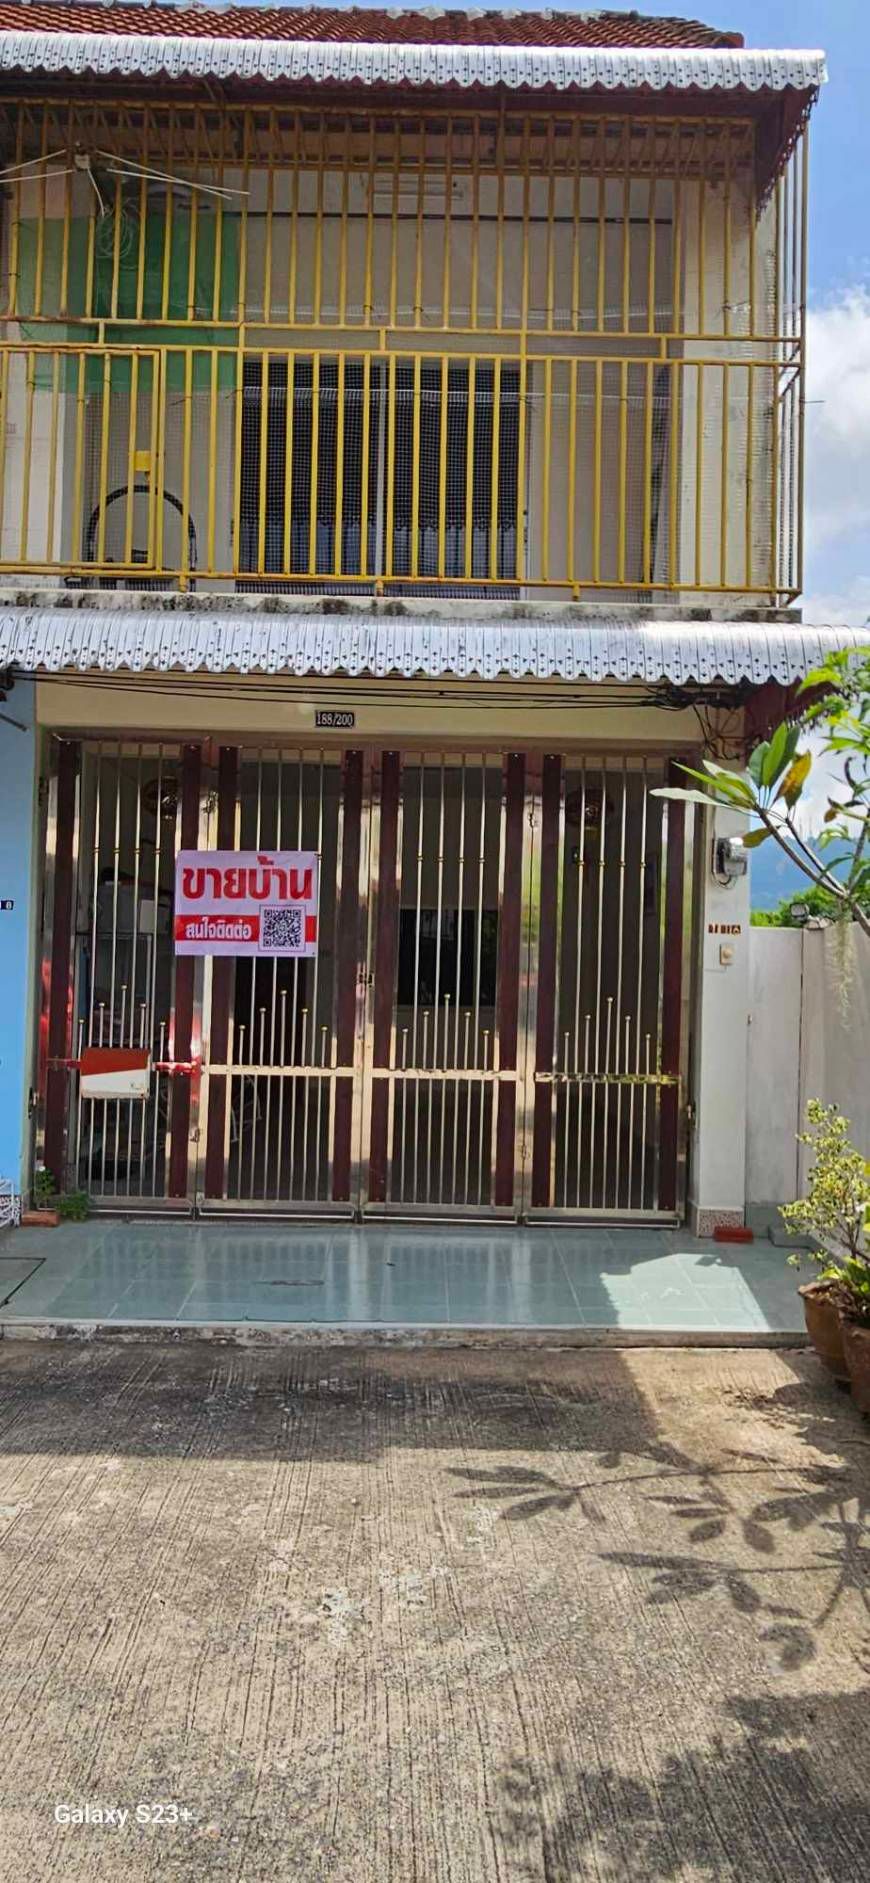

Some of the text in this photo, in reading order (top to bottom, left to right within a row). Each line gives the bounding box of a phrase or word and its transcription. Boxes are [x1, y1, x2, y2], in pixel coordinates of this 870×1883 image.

[317, 712, 353, 726] 188/200
[182, 855, 313, 900] ขายบ้าน
[185, 916, 252, 940] สนใจติดต่อ
